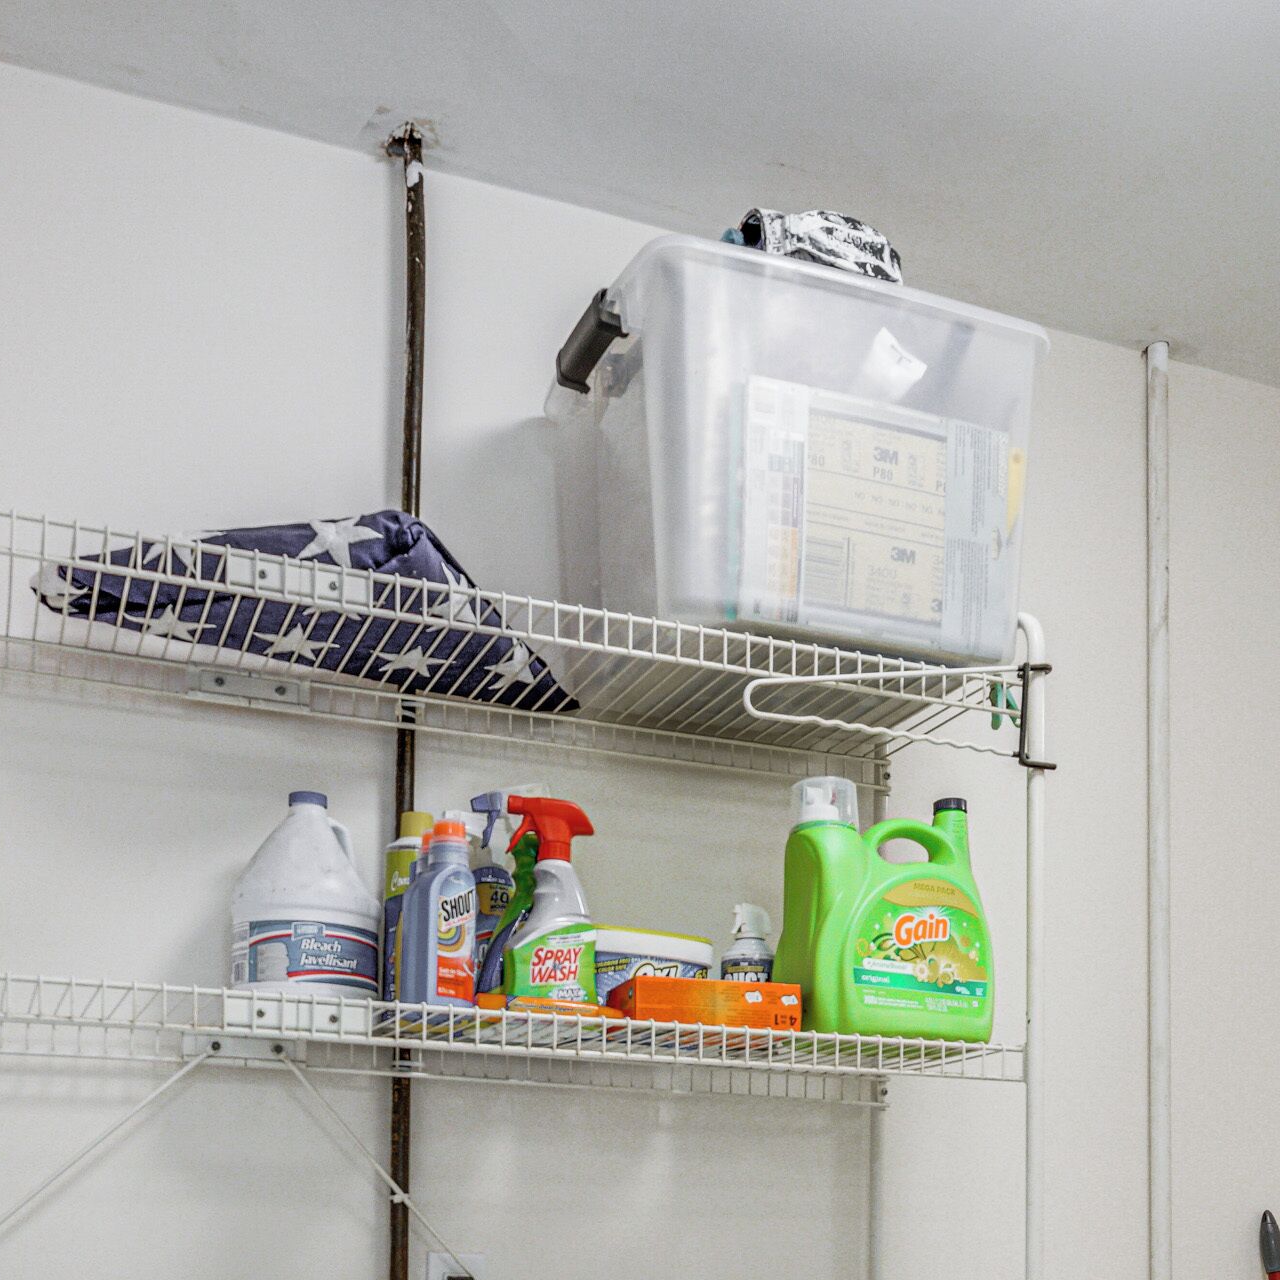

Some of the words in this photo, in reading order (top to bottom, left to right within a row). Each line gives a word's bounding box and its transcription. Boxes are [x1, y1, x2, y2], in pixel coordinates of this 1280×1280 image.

[808, 454, 825, 467] 80
[873, 445, 899, 466] 3M
[873, 466, 893, 482] P80
[891, 546, 917, 564] 3M
[441, 888, 475, 923] SHOUT
[490, 891, 510, 904] 40
[894, 913, 948, 947] Gain
[301, 938, 342, 952] Bleach
[531, 946, 584, 967] SPRAY
[530, 964, 579, 984] WASH
